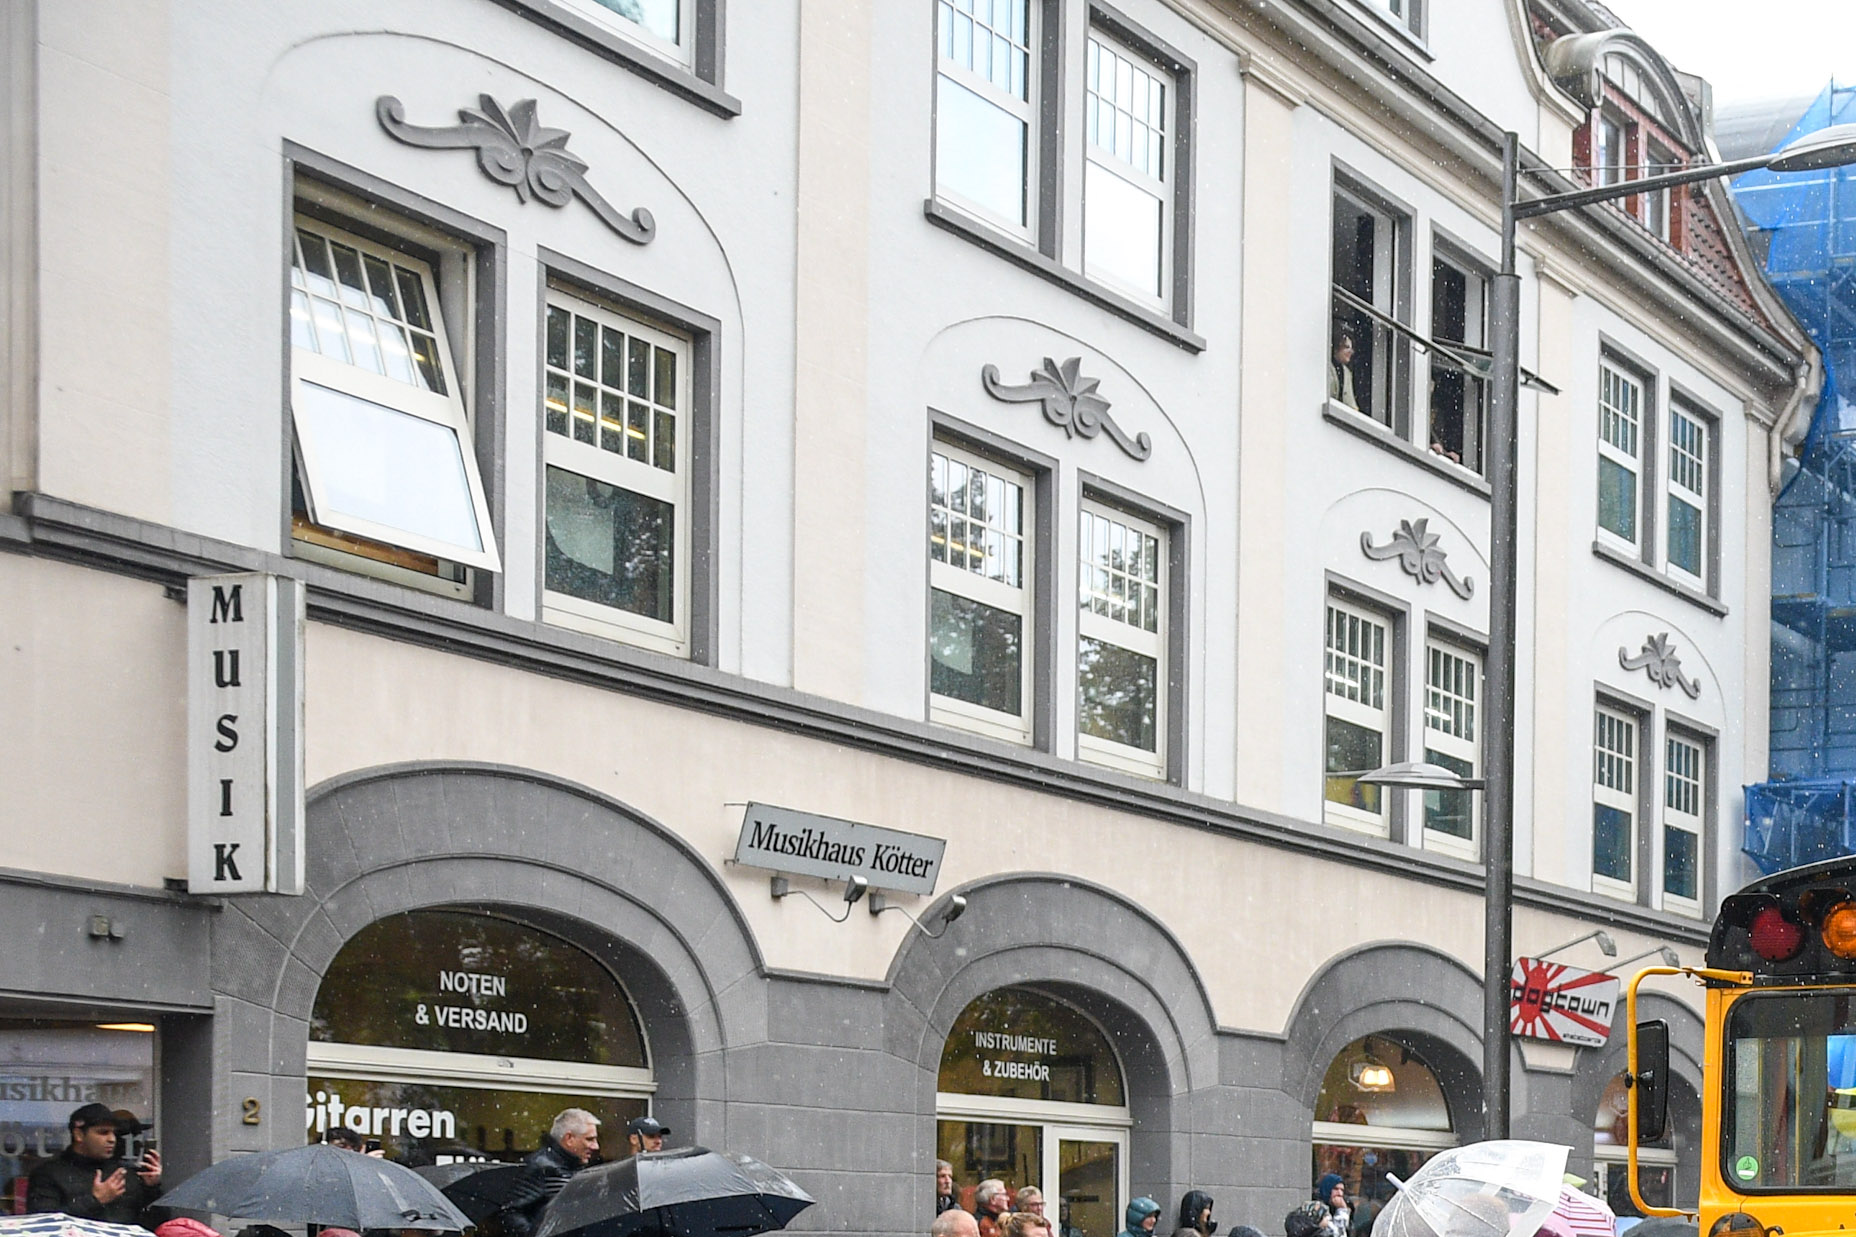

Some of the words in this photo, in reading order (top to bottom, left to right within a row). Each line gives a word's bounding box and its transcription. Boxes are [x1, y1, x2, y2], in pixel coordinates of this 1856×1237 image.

[209, 584, 244, 881] MUSIK
[748, 820, 866, 867] Musikhaus
[870, 843, 934, 878] Kötter
[439, 970, 506, 997] NOTEN
[414, 1003, 430, 1025] &
[434, 1005, 528, 1034] VERSAND
[975, 1031, 1057, 1055] INSTRUMENTE
[982, 1059, 992, 1077] &
[993, 1060, 1050, 1082] ZUBEHÖR
[242, 1097, 261, 1125] 2
